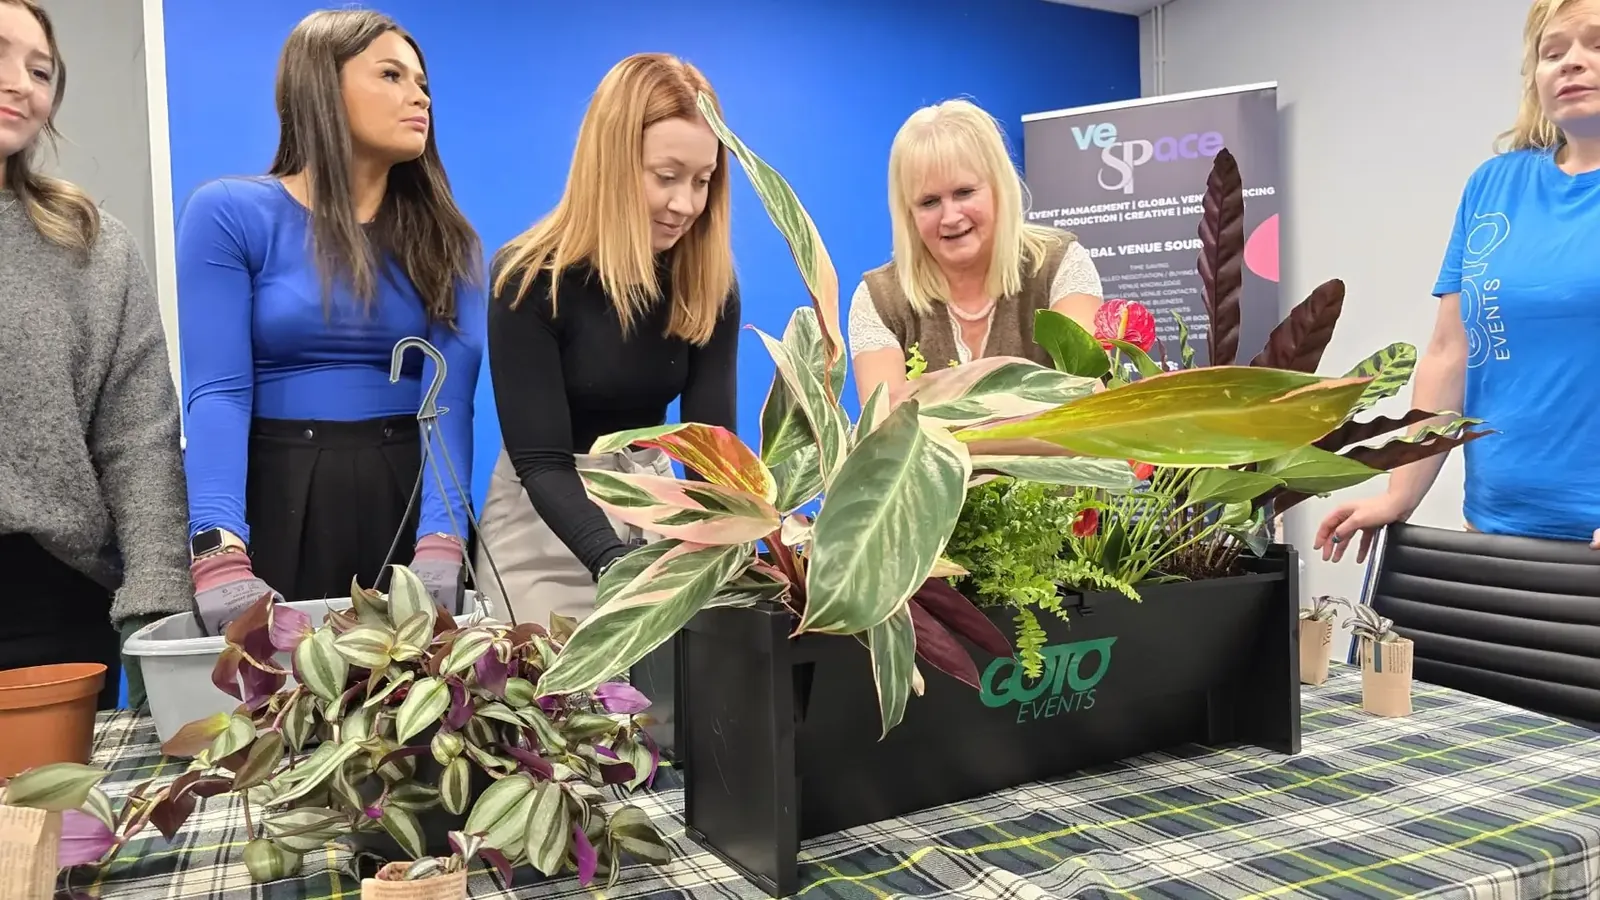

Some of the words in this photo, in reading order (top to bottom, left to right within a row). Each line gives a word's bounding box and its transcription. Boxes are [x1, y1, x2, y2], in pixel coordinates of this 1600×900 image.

[1028, 209, 1060, 220] EVENT
[1061, 202, 1131, 217] MANAGEMENT
[1137, 197, 1179, 209] GLOBAL
[1180, 193, 1204, 205] VEN
[1242, 186, 1276, 198] RCING
[1053, 214, 1118, 227] PRODUCTION
[1124, 207, 1175, 221] CREATIVE
[1118, 243, 1163, 256] VENUE
[1164, 238, 1204, 252] SOUR
[1162, 287, 1198, 296] CONTACTS
[1482, 278, 1511, 361] EVENTS
[979, 636, 1119, 708] GOTO
[1016, 688, 1097, 724] EVENTS
